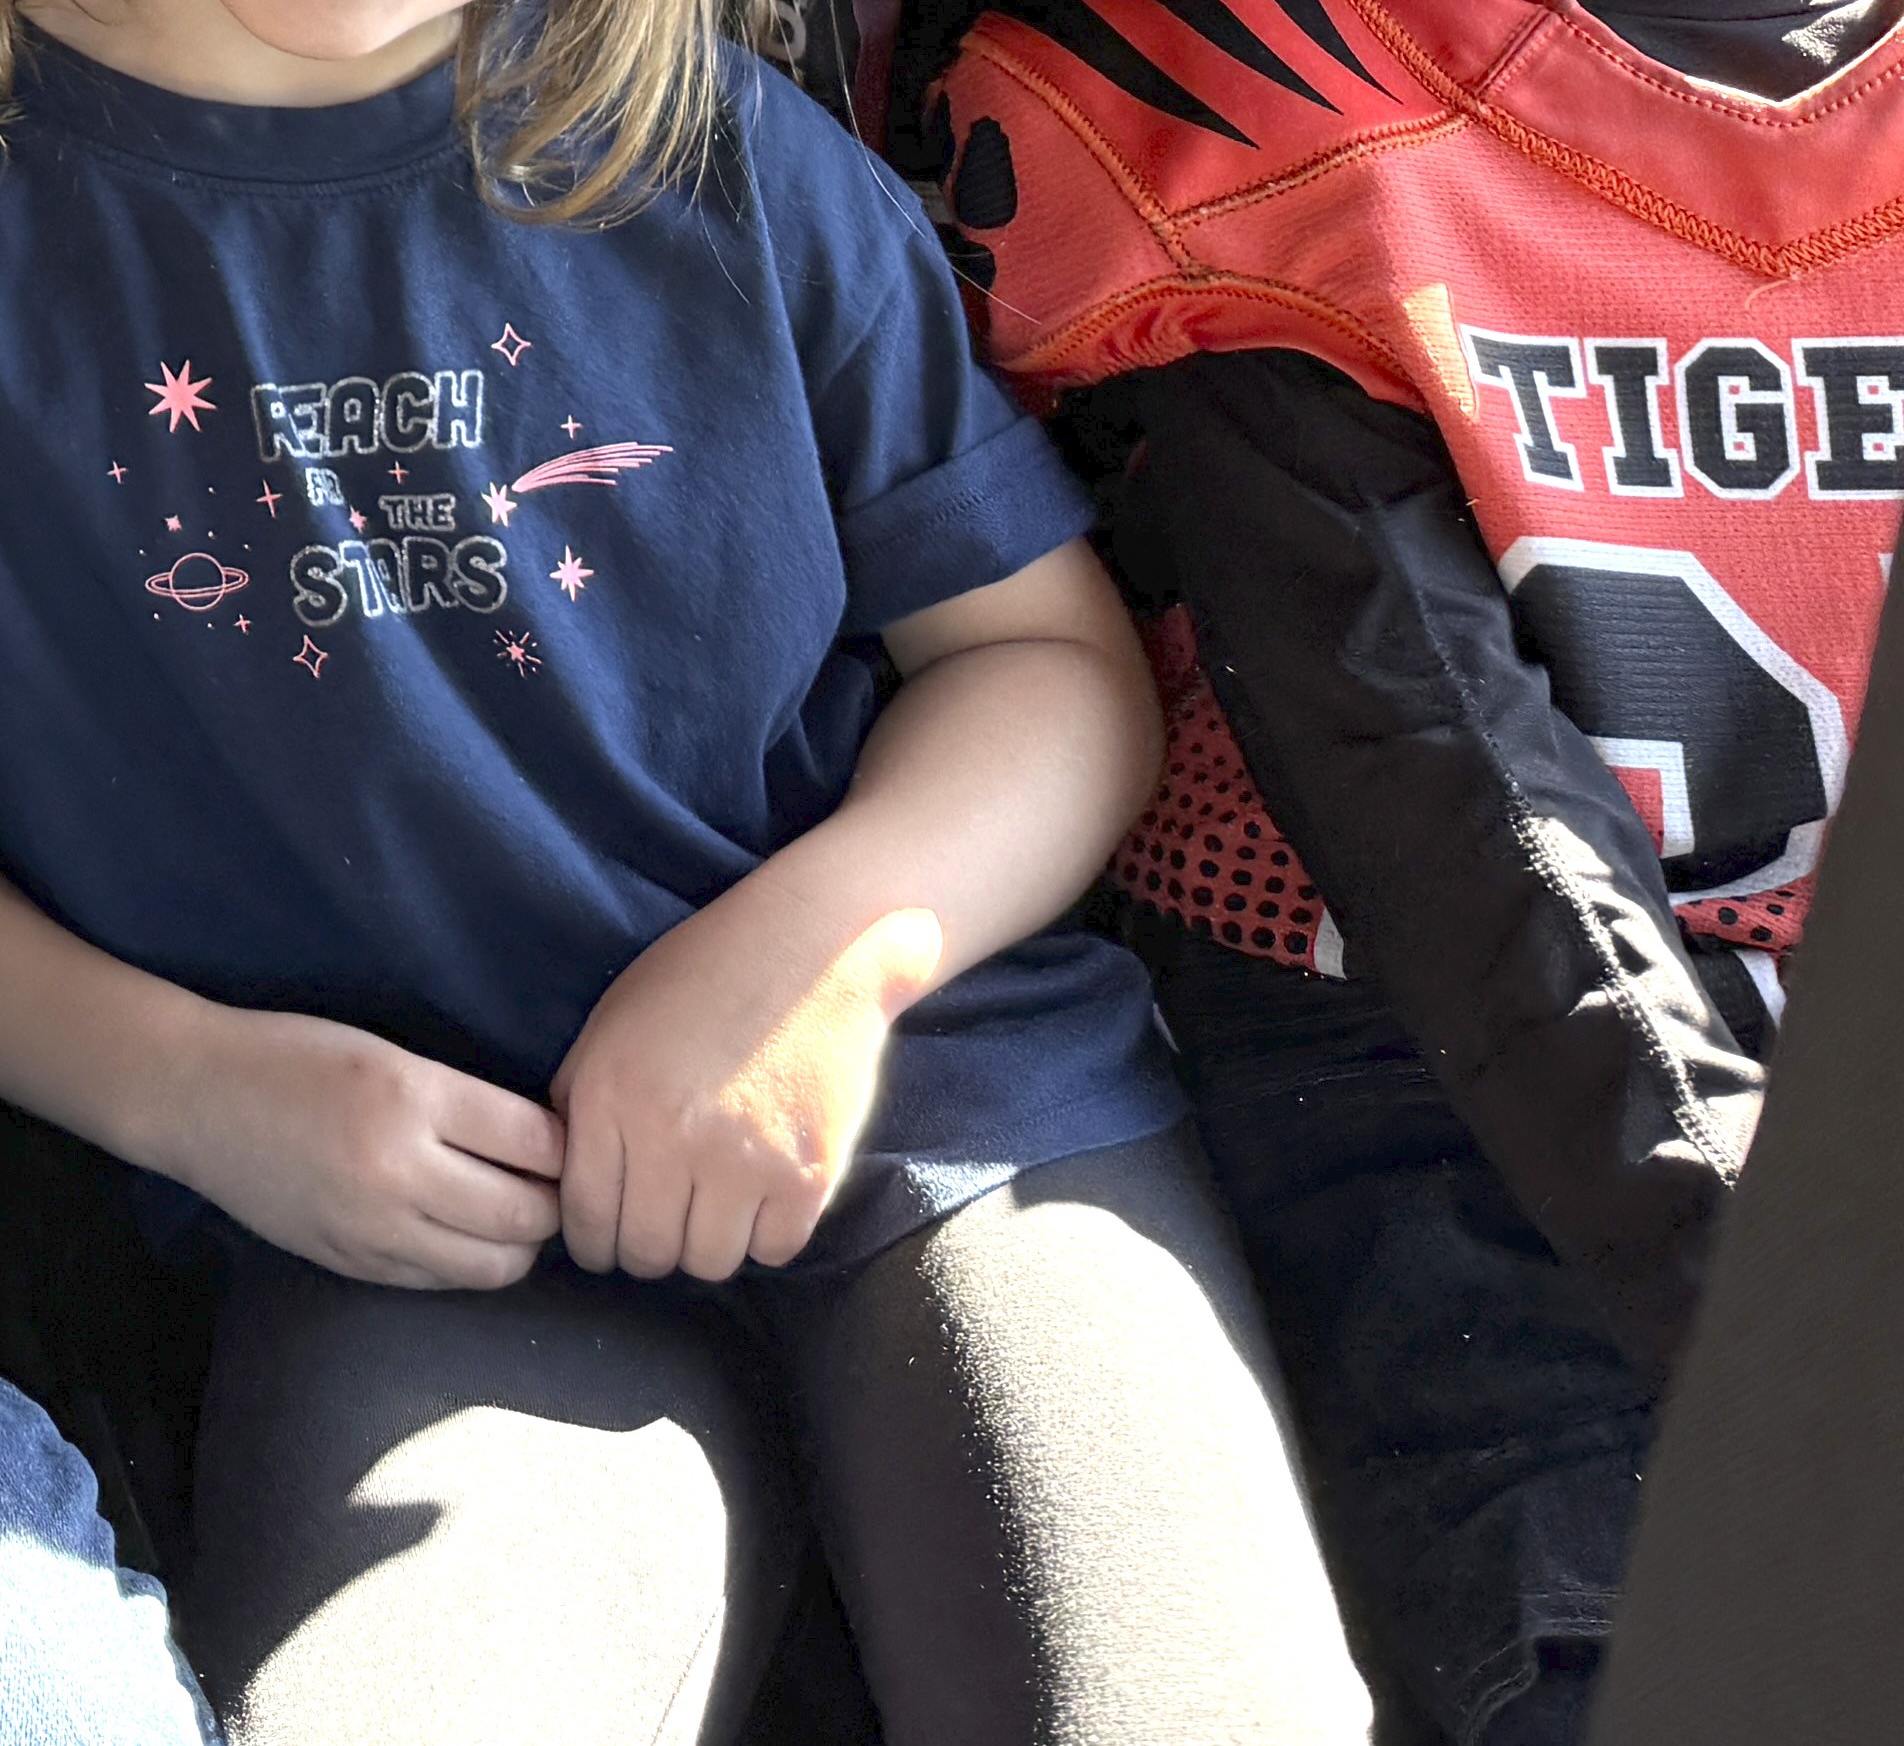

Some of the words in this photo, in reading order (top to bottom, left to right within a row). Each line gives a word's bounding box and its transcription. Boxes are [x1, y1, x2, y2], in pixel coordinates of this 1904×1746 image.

[249, 368, 486, 464] REACH
[377, 492, 457, 532] THE
[289, 534, 509, 629] STARS
